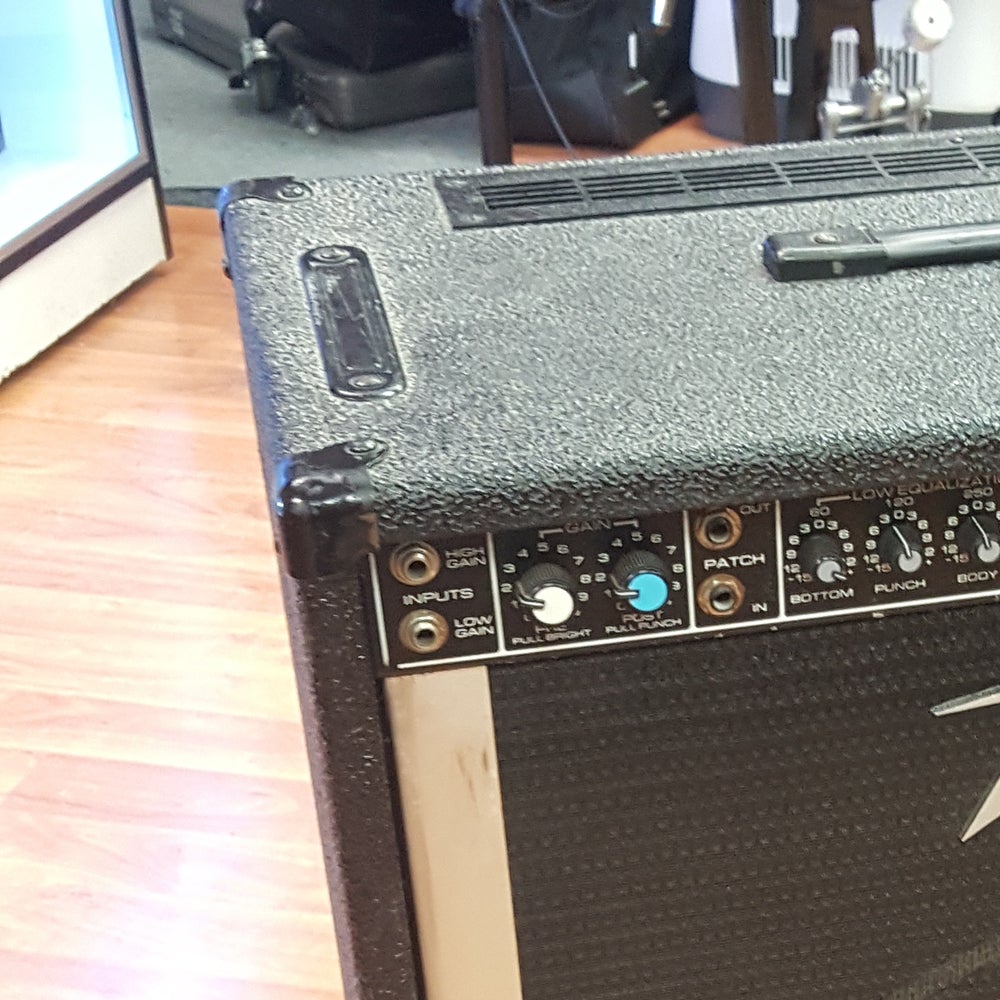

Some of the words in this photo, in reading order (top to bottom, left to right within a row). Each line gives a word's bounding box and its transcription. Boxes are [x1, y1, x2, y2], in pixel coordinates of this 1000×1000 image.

[851, 486, 892, 501] LOW
[740, 502, 771, 515] OUT
[958, 504, 969, 515] 3
[972, 500, 983, 510] 0
[879, 513, 890, 524] 3
[893, 509, 905, 520] 0
[799, 523, 811, 534] 3
[813, 519, 825, 529] 0
[597, 552, 610, 563] 3
[611, 538, 623, 547] 4
[631, 531, 643, 541] 5
[650, 533, 662, 544] 6
[666, 545, 677, 555] 7
[446, 556, 487, 569] GAIN
[503, 563, 516, 573] 3
[517, 548, 528, 558] 4
[537, 542, 549, 552] 5
[557, 544, 569, 554] 6
[572, 555, 584, 566] 7
[703, 553, 766, 571] PATCH
[957, 569, 998, 583] BODY
[874, 578, 927, 594] PUNCH
[402, 588, 474, 606] INPUTS
[790, 588, 854, 605] BOTTOM
[751, 602, 768, 613] IN
[454, 615, 493, 628] LOW
[455, 626, 495, 638] GAIN
